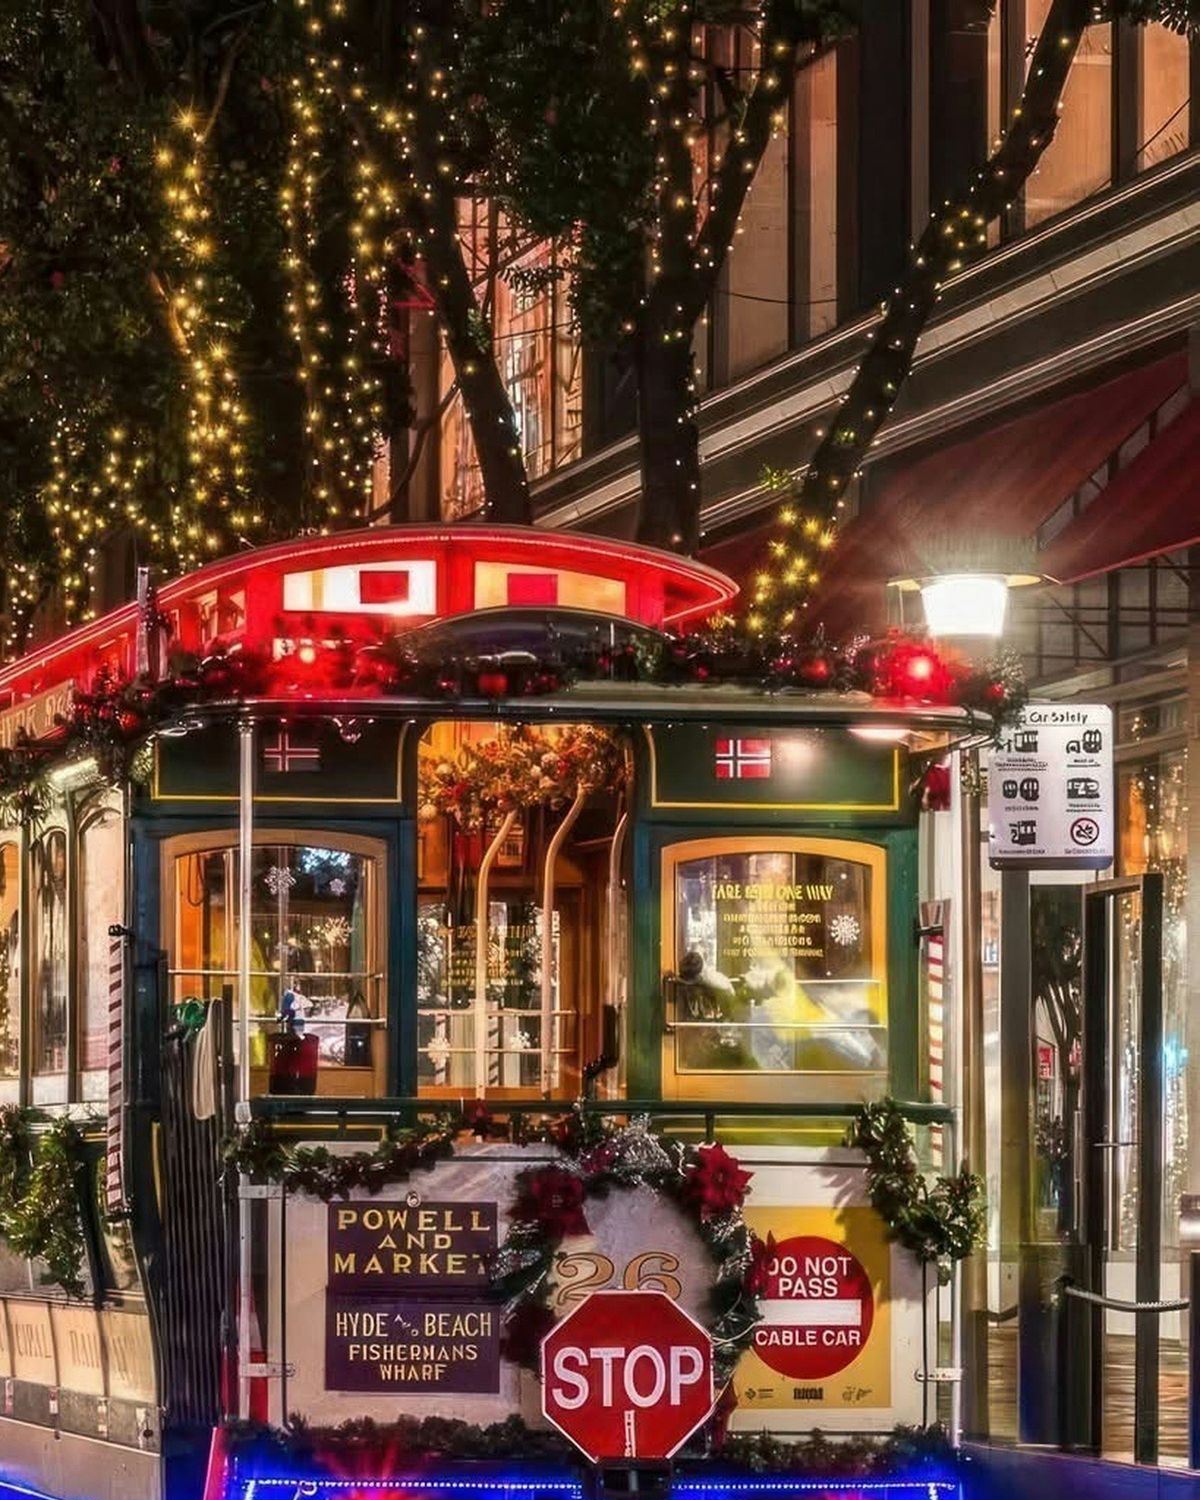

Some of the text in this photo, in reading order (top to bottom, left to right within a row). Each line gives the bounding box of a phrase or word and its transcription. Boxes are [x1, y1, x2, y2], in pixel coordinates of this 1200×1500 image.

[337, 1209, 490, 1231] POWELL
[378, 1233, 452, 1249] AND
[805, 1256, 852, 1276] NOT
[557, 1252, 682, 1306] 26
[778, 1278, 839, 1297] PASS
[336, 1312, 390, 1337] HYDE
[424, 1312, 492, 1337] BEACH
[755, 1330, 861, 1346] CABLE CAR
[349, 1344, 478, 1361] FISHERMANS
[380, 1364, 447, 1381] WHARF
[552, 1345, 704, 1409] STOP
